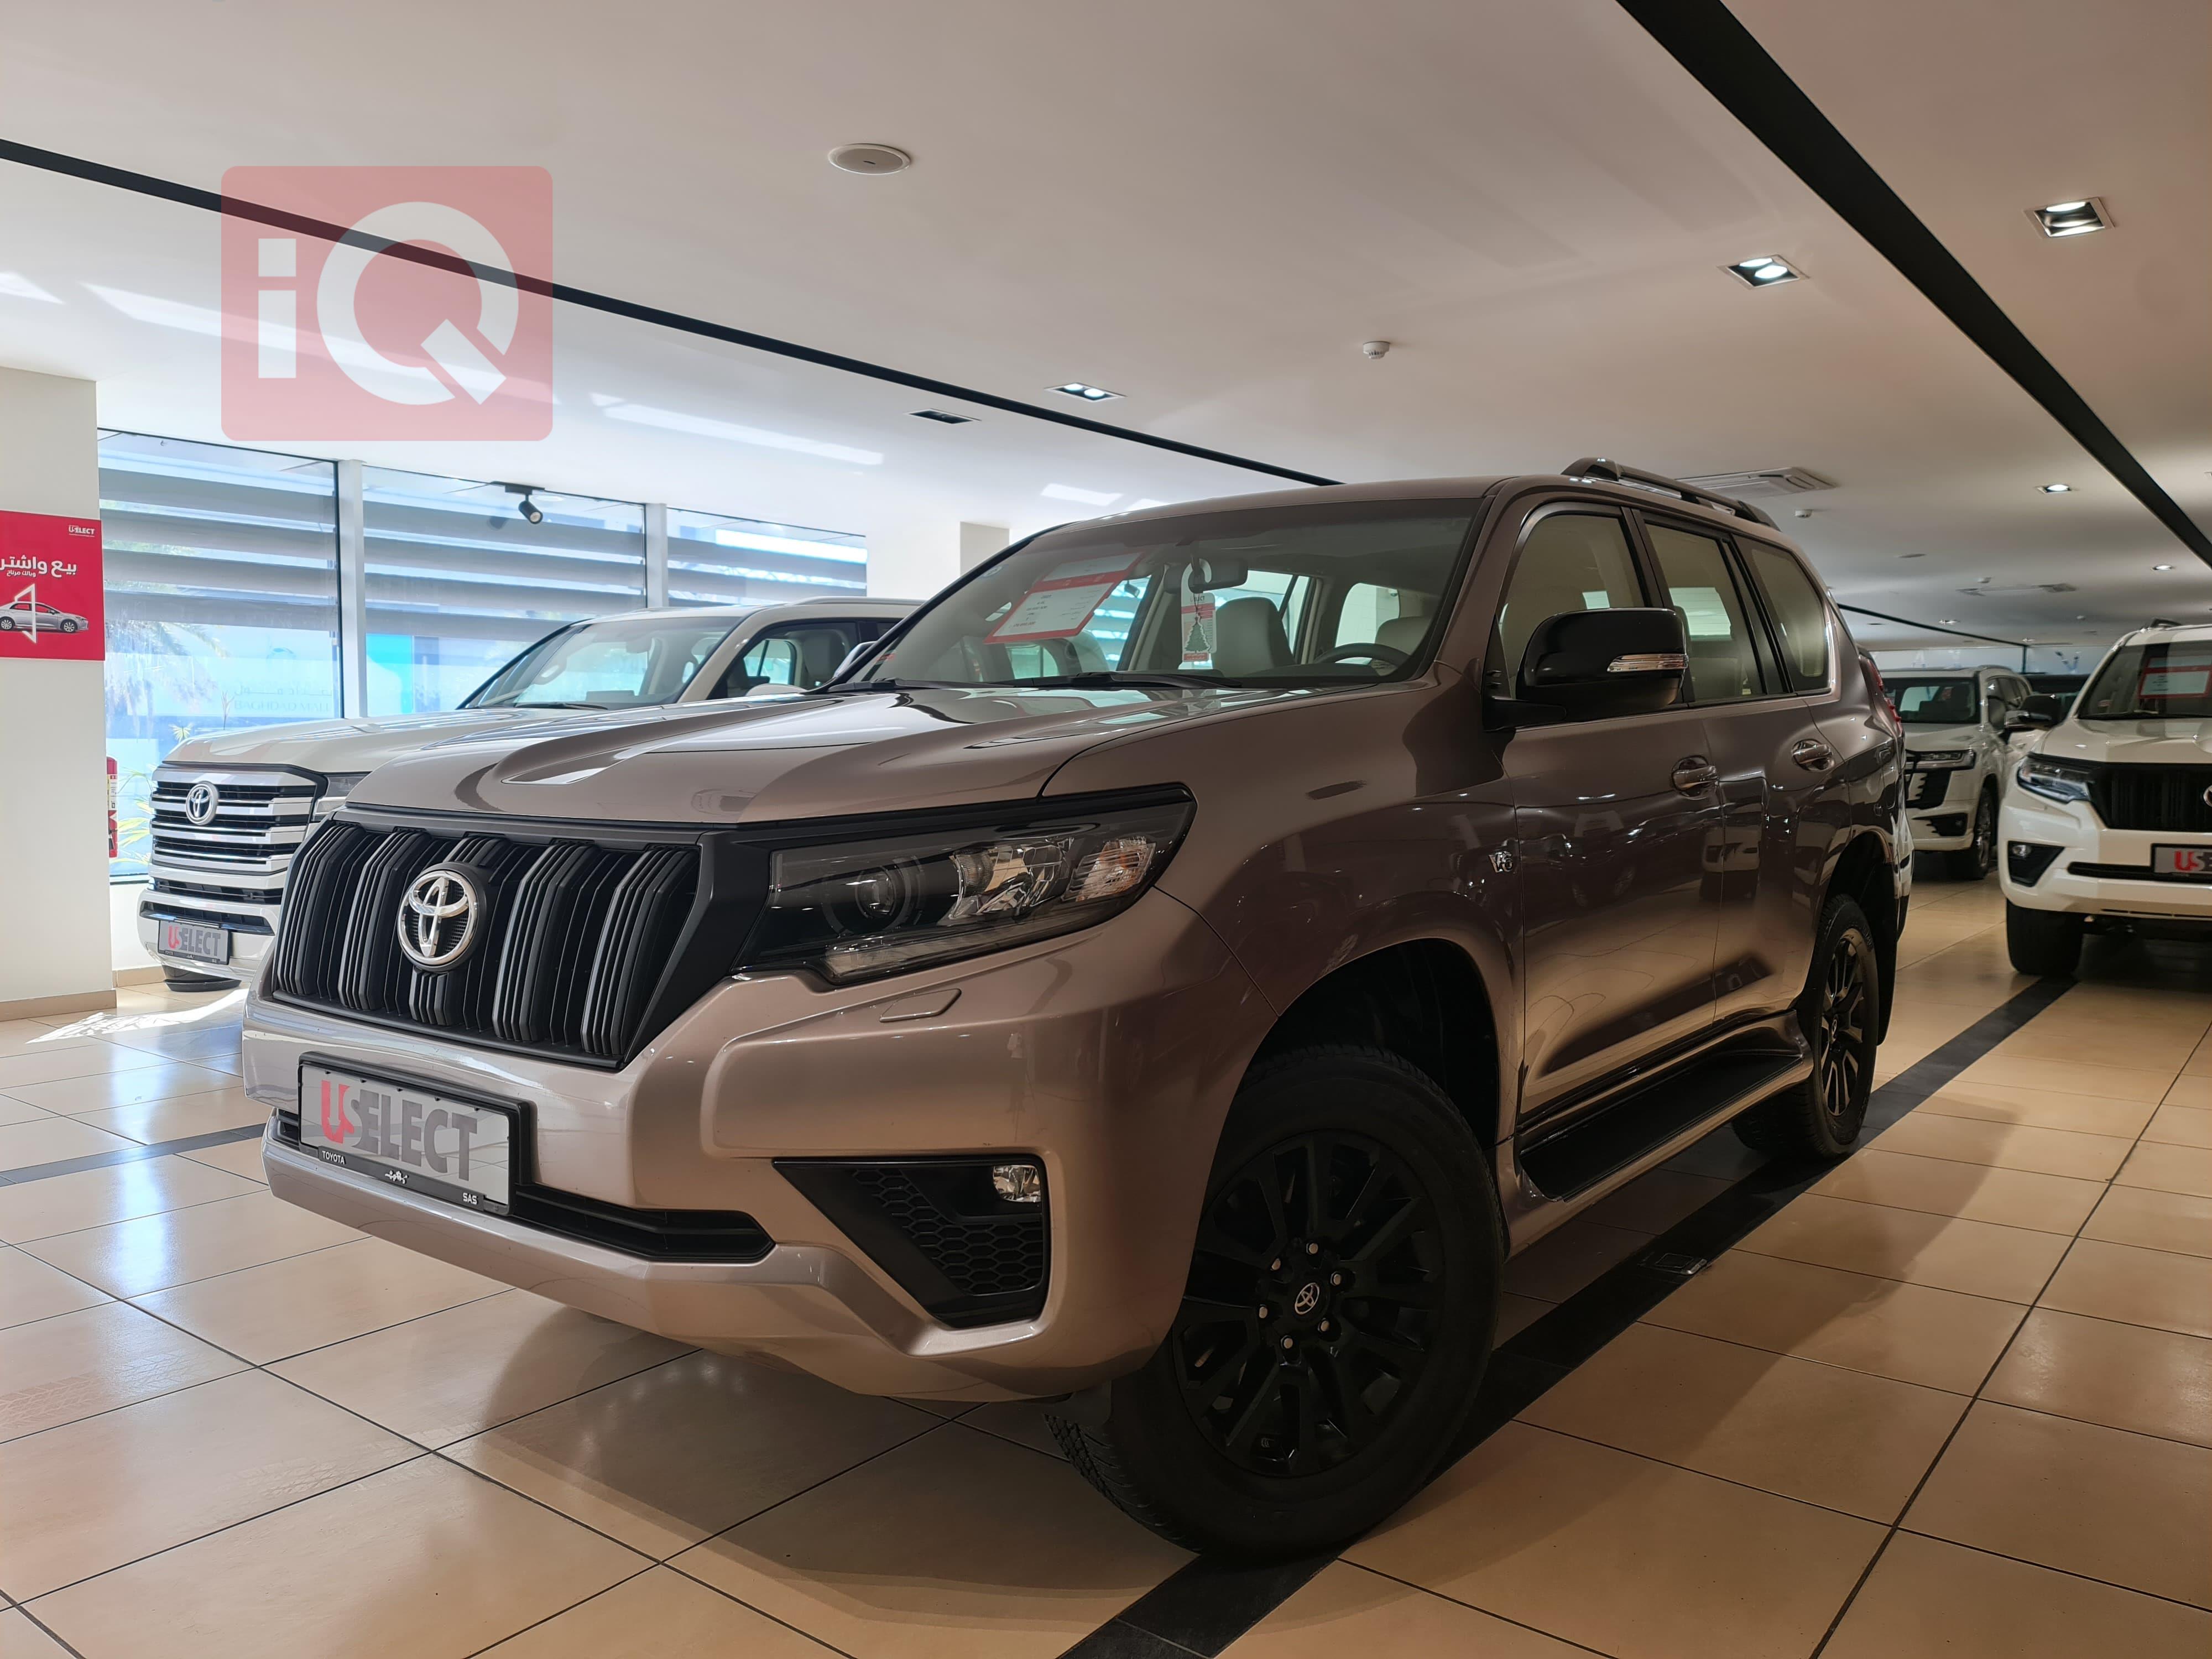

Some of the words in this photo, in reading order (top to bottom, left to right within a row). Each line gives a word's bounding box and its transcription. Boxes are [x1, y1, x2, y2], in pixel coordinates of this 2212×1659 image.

[51, 560, 77, 578] بيع
[234, 700, 297, 711] BAGHDAD
[1488, 851, 1513, 873] V6
[168, 924, 221, 957] USELECT
[321, 1079, 478, 1182] USELECT
[322, 1150, 346, 1165] TOYOTA
[462, 1192, 478, 1205] SAS
